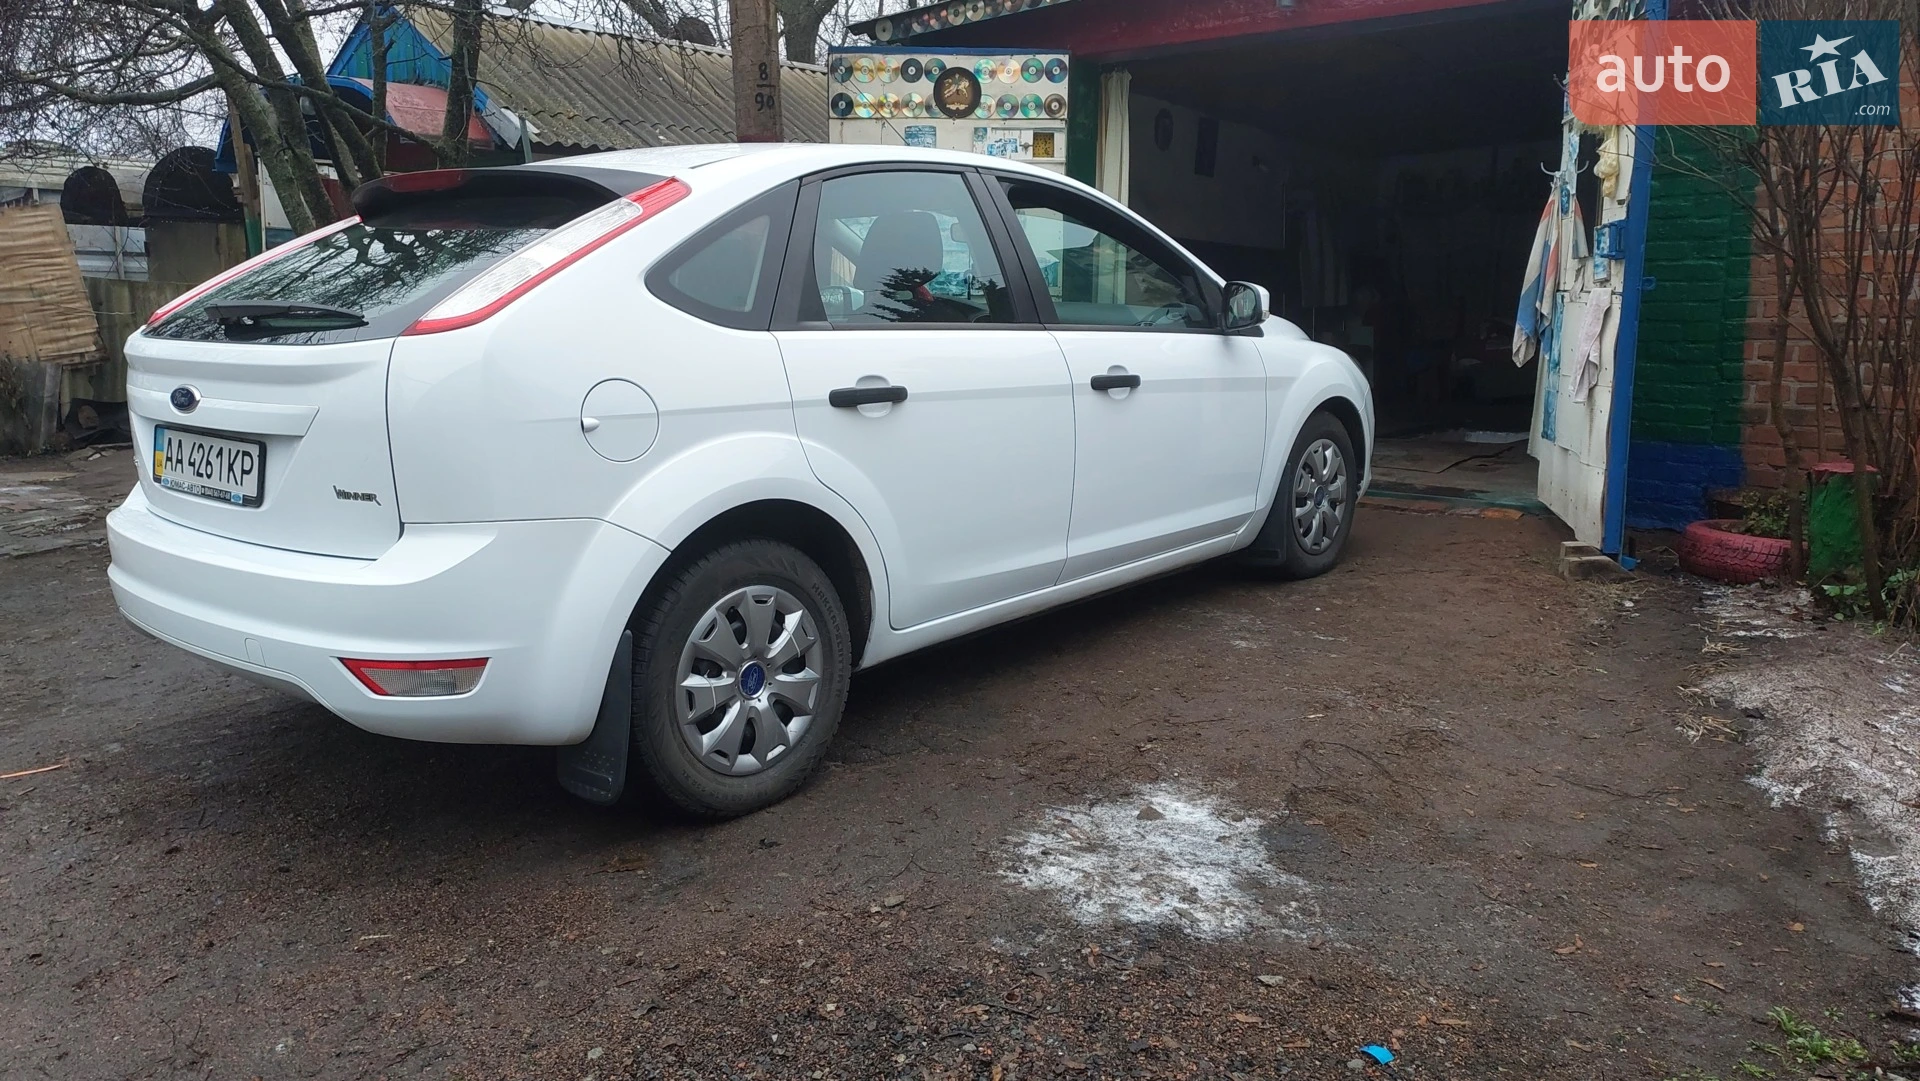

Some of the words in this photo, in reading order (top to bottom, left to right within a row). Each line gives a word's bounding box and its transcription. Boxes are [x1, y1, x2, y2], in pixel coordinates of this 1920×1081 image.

[758, 62, 768, 80] 8
[755, 92, 775, 111] 90
[164, 437, 184, 474] AA
[188, 441, 223, 482] 4261
